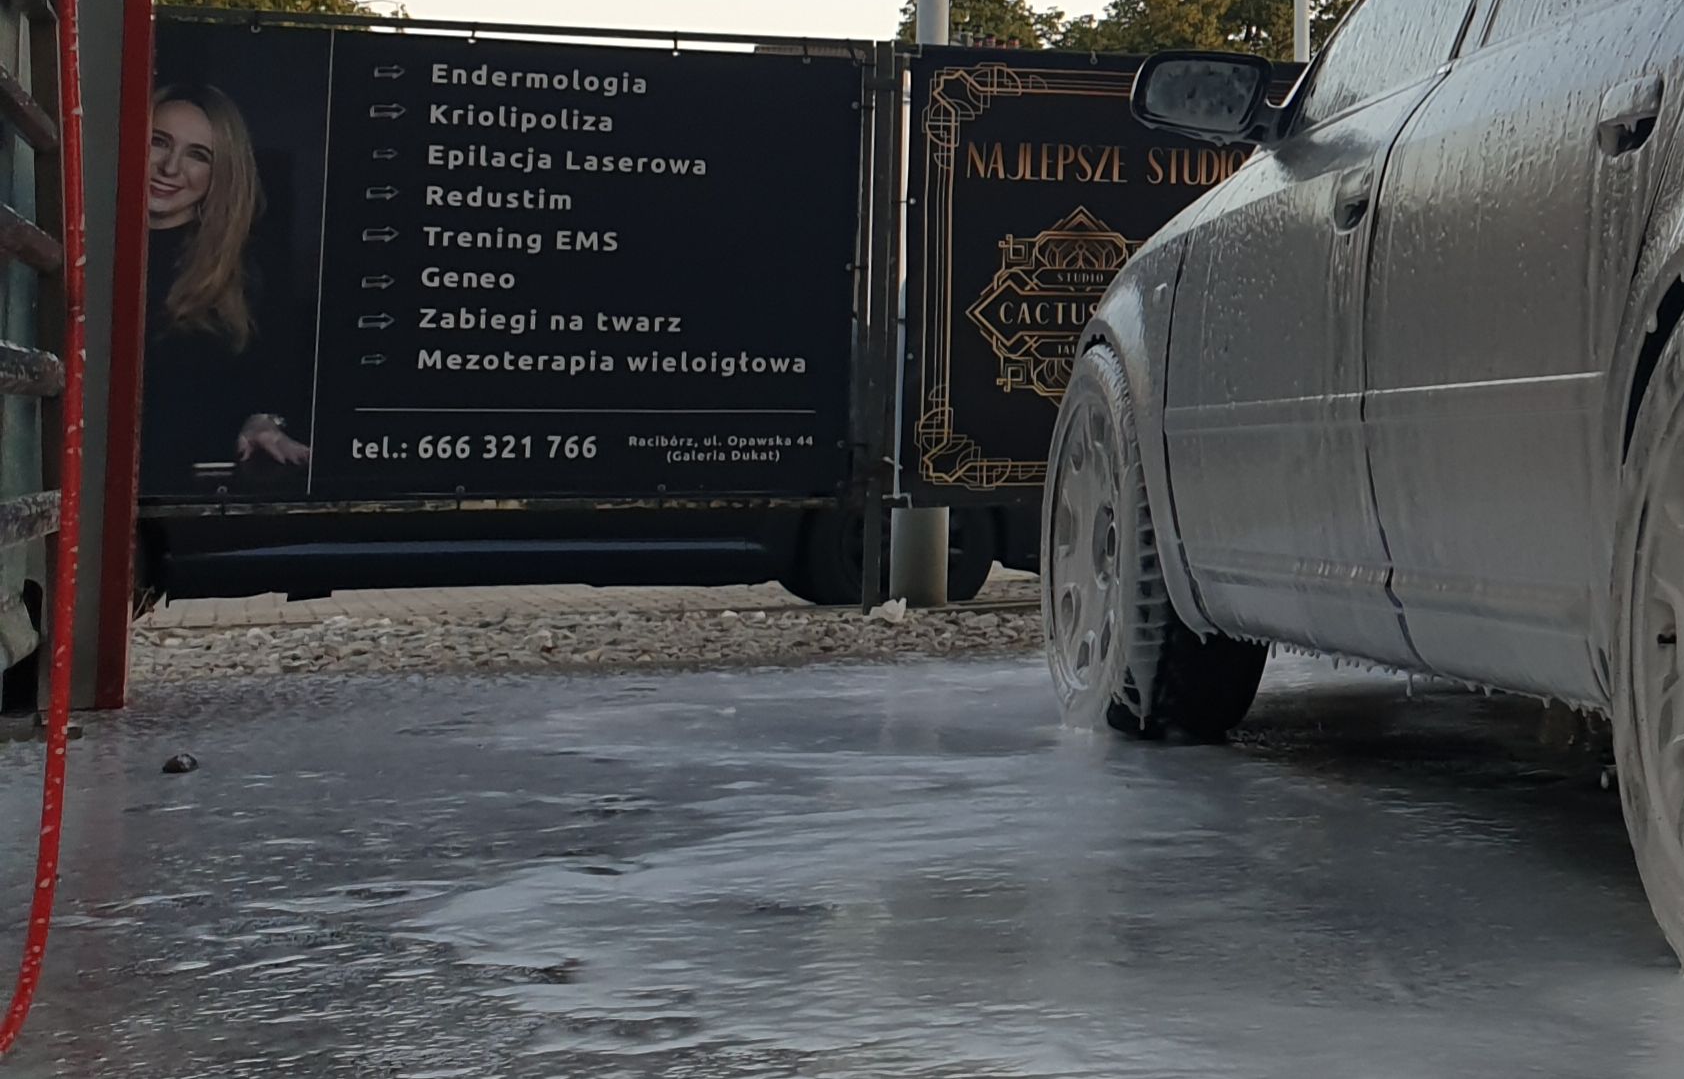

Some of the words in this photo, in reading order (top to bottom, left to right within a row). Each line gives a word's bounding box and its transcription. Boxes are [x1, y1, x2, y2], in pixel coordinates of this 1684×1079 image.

[431, 63, 648, 96] Endermologia
[429, 104, 613, 133] Kriolipoliza
[428, 144, 552, 172] Epilacja
[566, 150, 707, 175] Laserowa
[966, 141, 1128, 183] NAJLEPSZE
[426, 185, 572, 211] Redustim
[423, 226, 542, 254] Trening
[556, 230, 619, 252] EMS
[421, 266, 515, 290] Geneo
[1057, 272, 1104, 283] STUDIO
[419, 307, 537, 334] Zabiegi
[551, 314, 583, 331] na
[598, 312, 682, 333] twarz
[418, 349, 614, 376] Mezoterapia
[627, 350, 806, 377] wieloigłowa
[352, 435, 408, 459] tel.:
[418, 435, 471, 460] 666
[482, 434, 532, 459] 321
[546, 435, 597, 459] 766
[628, 435, 699, 448] Racibórz,
[704, 435, 722, 447] ul.
[728, 435, 792, 448] Opawska
[797, 435, 814, 446] 44
[667, 450, 726, 464] (Galeria
[731, 450, 780, 463] Dukat)
